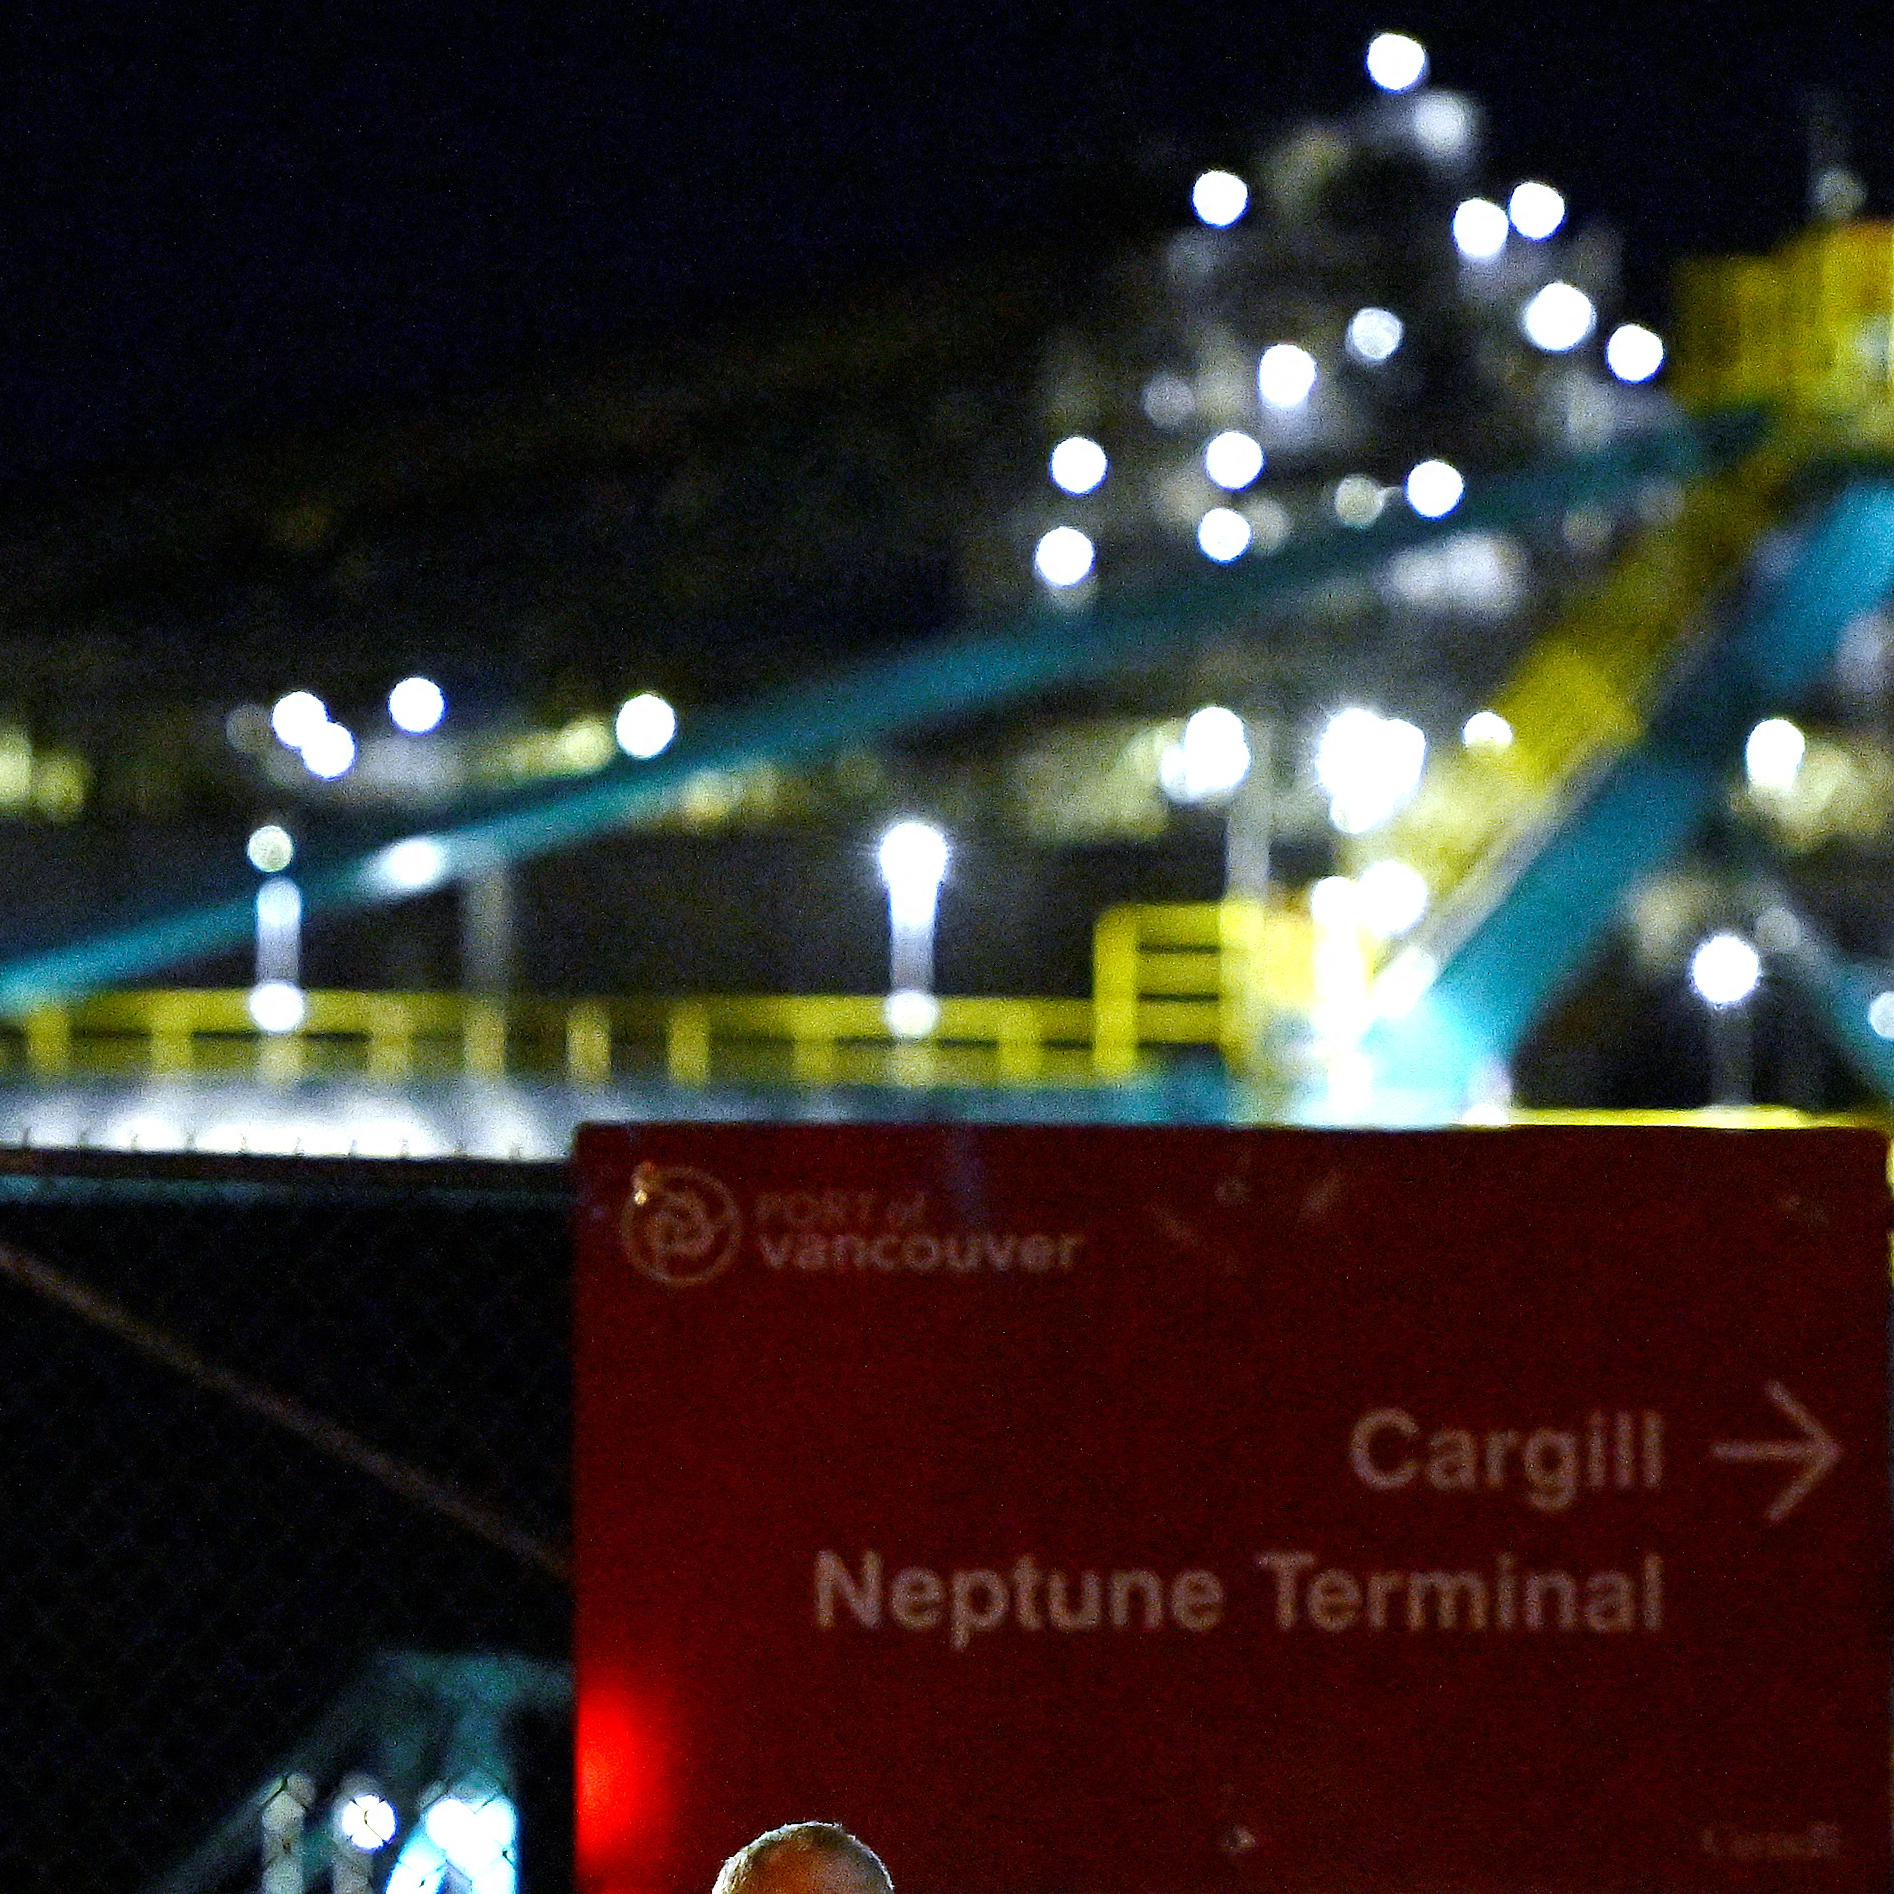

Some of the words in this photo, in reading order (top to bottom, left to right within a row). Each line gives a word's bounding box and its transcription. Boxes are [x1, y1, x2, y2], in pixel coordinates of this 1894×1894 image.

[758, 1232, 1083, 1271] vancouver
[1347, 1407, 1665, 1512] Cargill
[812, 1549, 1225, 1651] Neptune
[1258, 1549, 1666, 1634] Terminal
